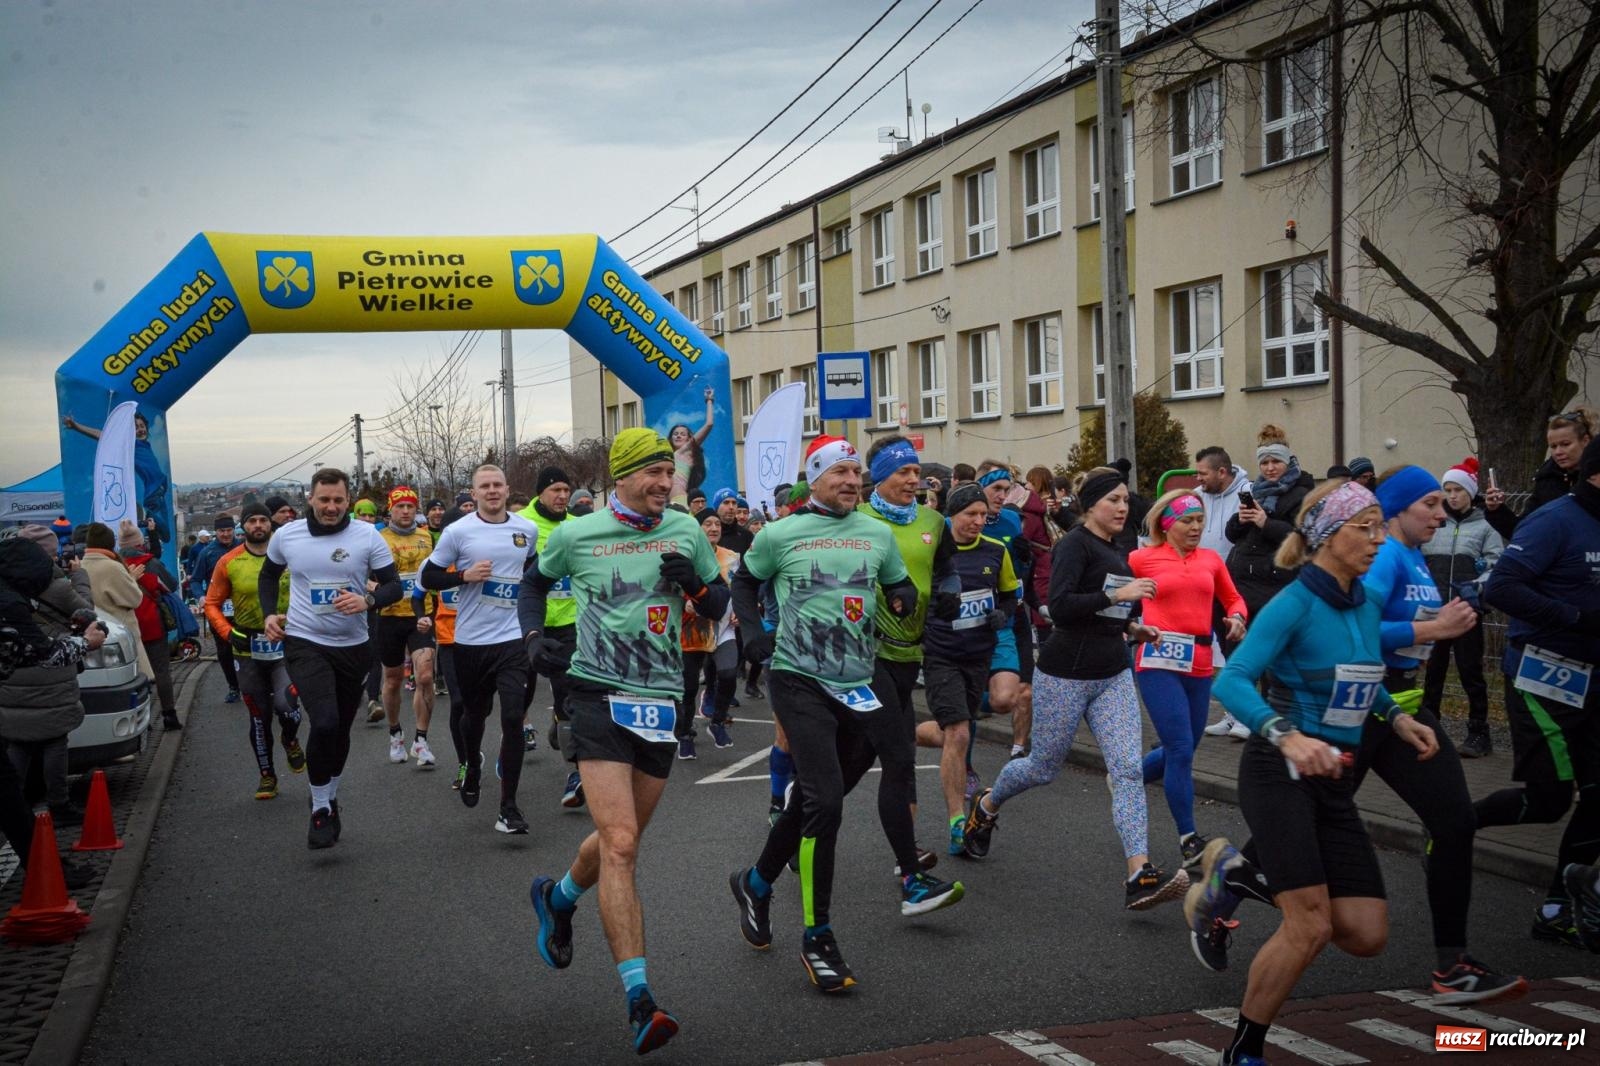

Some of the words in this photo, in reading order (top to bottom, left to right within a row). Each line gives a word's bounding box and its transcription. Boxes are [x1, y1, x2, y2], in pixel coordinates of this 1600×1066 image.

[362, 249, 465, 267] Gmina
[338, 269, 494, 290] Pietrowice
[358, 293, 474, 312] Wielkie
[102, 317, 168, 375] Gmina
[160, 270, 216, 321] ludzi
[602, 269, 657, 325] Gmina
[655, 317, 703, 363] ludzi
[131, 296, 236, 393] aktywnych
[586, 293, 683, 381] aktywnych
[592, 540, 679, 558] CURSORES
[794, 538, 872, 553] CURSORES
[493, 583, 513, 598] 46
[959, 599, 989, 618] 200
[1539, 662, 1572, 688] 79
[631, 705, 660, 728] 18
